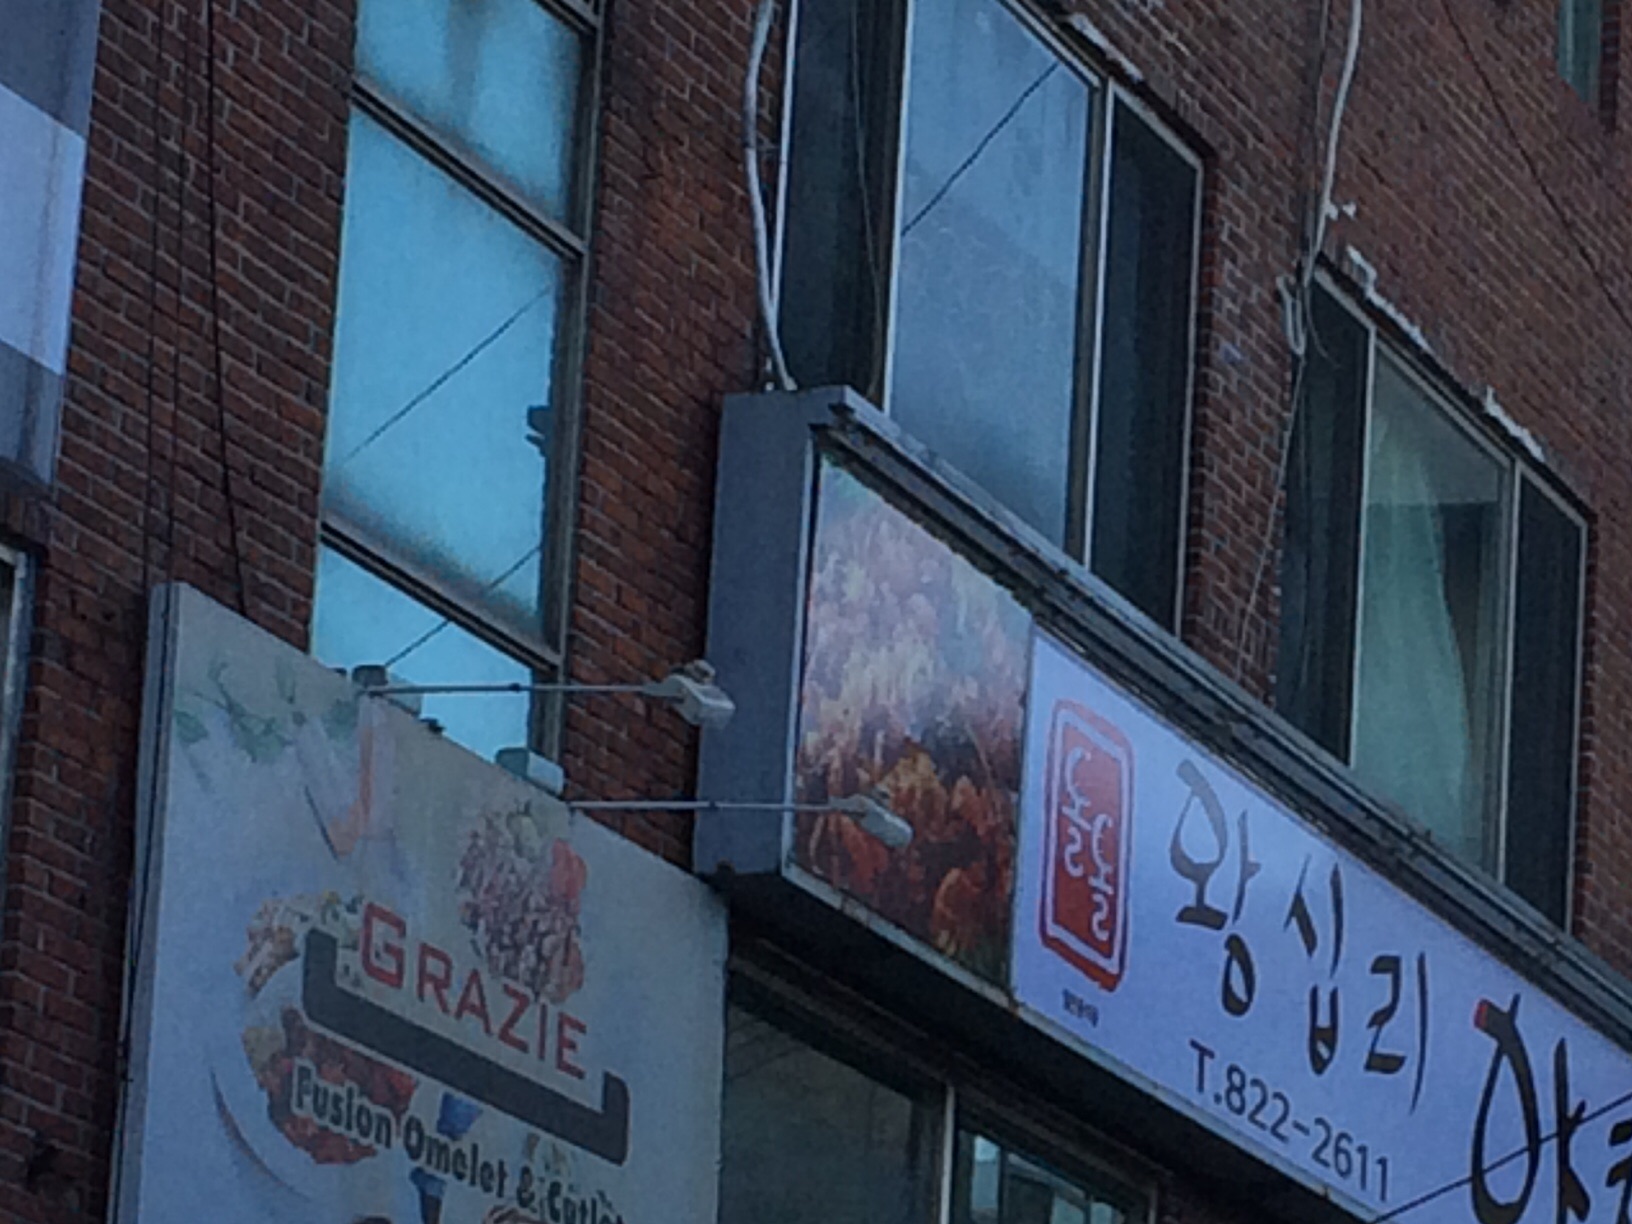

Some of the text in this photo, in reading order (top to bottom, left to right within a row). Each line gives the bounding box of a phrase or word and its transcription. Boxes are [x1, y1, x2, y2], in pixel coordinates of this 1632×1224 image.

[360, 901, 590, 1081] GRAZIE
[1168, 757, 1430, 1114] 왕십리
[290, 1064, 394, 1151] Fusion
[403, 1115, 508, 1199] Omelet
[515, 1166, 536, 1209] &
[1187, 1040, 1392, 1202] T.822-2611
